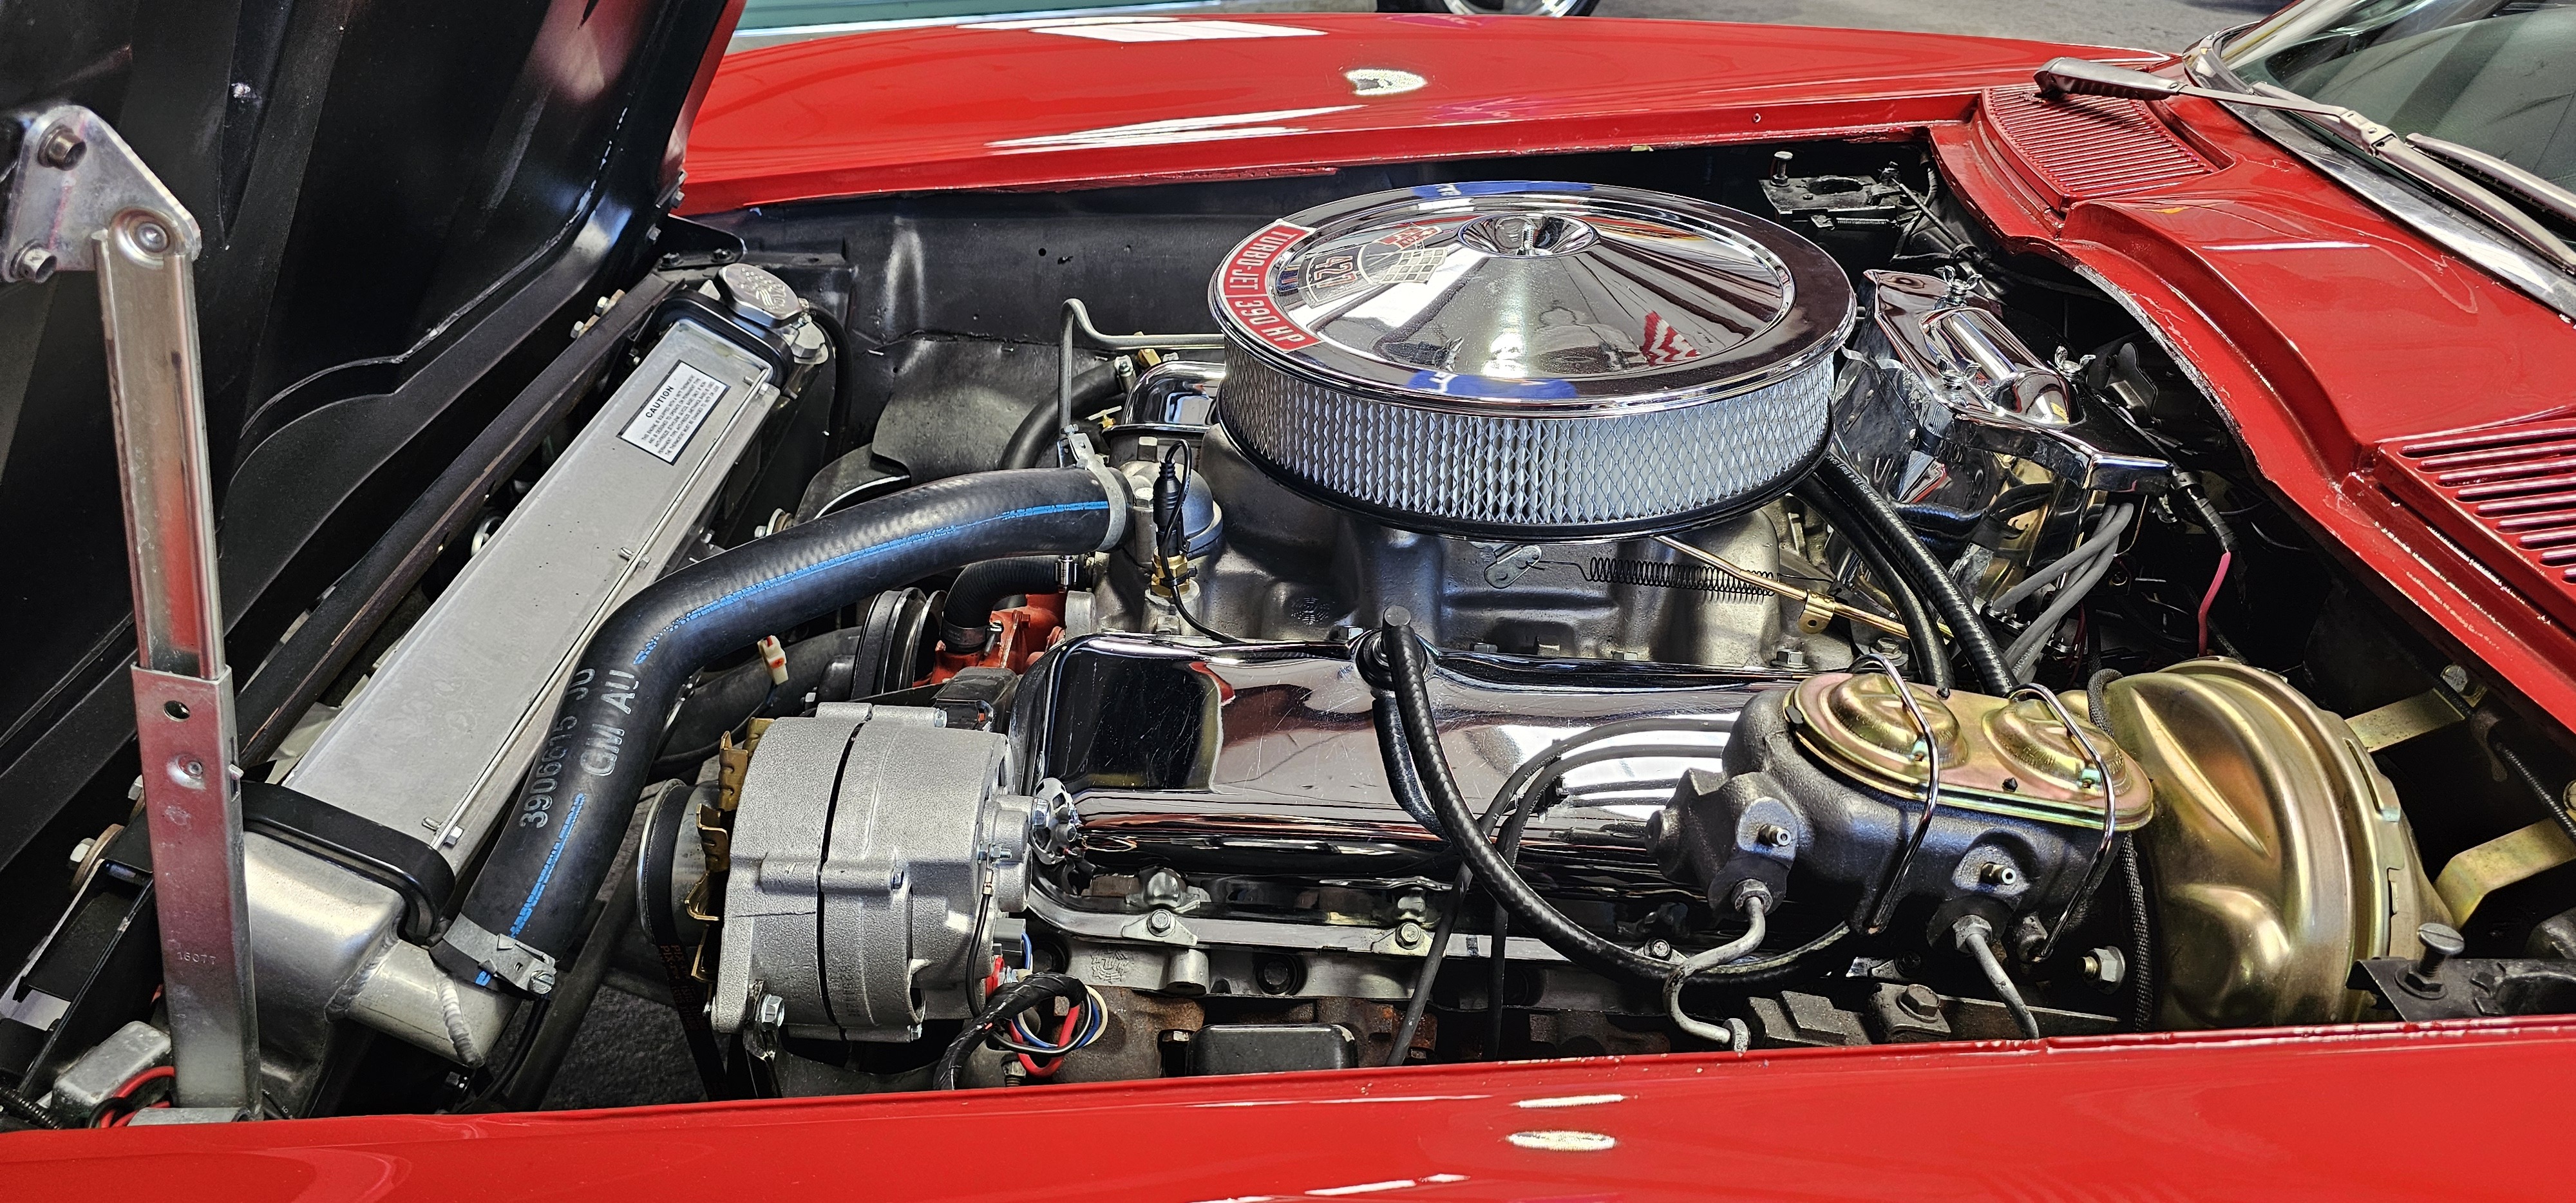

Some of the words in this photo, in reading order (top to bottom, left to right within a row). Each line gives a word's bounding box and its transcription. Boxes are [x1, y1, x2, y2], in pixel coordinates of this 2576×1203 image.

[1229, 231, 1298, 290] TURBO-JET
[1312, 255, 1357, 289] 427
[1235, 299, 1281, 325] 390
[1261, 325, 1306, 343] HP
[645, 385, 674, 418] CAUTION
[580, 723, 626, 777] GM
